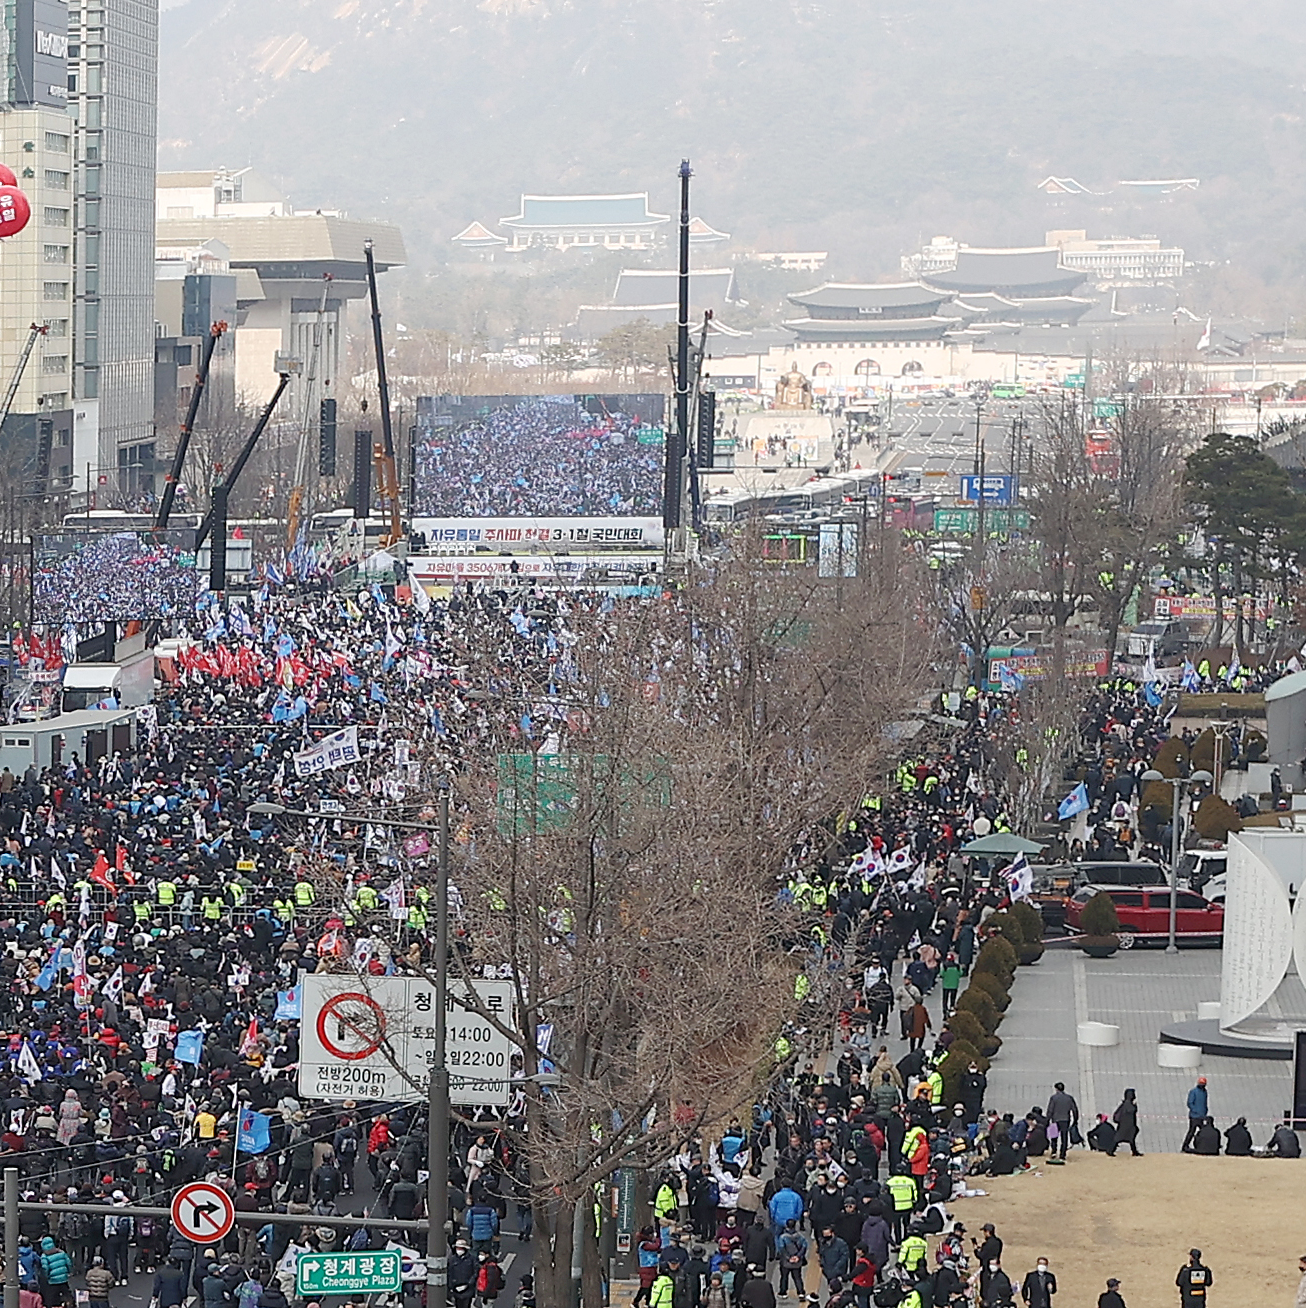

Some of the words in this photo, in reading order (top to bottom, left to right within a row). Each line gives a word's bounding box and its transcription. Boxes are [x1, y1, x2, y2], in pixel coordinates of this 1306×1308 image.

[430, 528, 481, 541] 자유통일
[484, 528, 522, 541] 주사파
[552, 528, 589, 541] 3·1절
[592, 528, 643, 541] 국민대회
[317, 1066, 386, 1084] 전방200m
[323, 1257, 396, 1275] 청계광장
[321, 1276, 369, 1289] Cheonggye
[371, 1274, 395, 1286] Plaza
